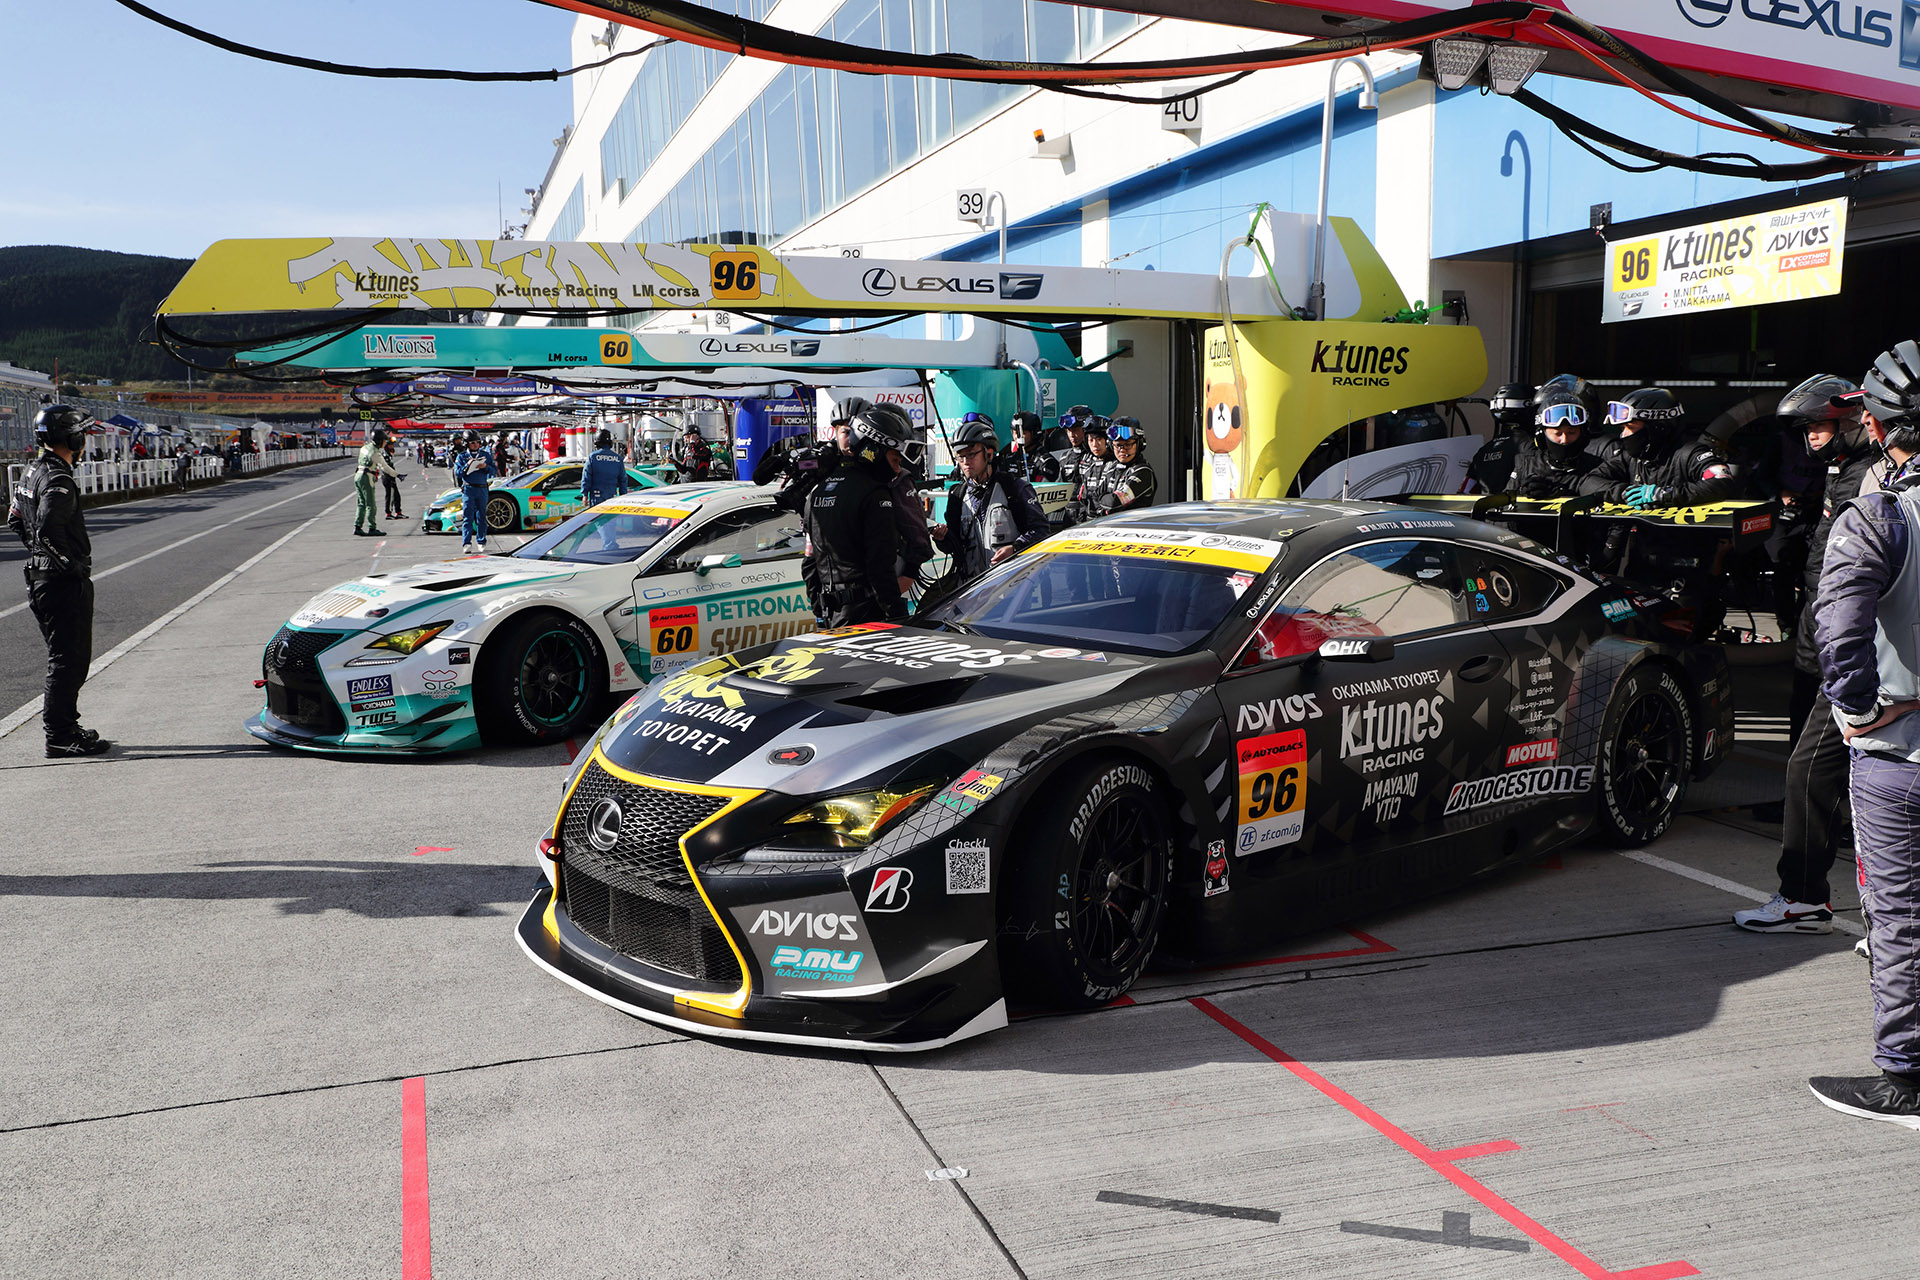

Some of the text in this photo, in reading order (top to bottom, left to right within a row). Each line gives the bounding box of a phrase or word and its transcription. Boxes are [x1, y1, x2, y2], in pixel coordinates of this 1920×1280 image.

[1740, 0, 1893, 48] LEXUS
[1165, 94, 1199, 122] 40
[959, 193, 983, 215] 39
[1770, 208, 1830, 228] 岡山トヨペット
[1767, 226, 1829, 253] ADVICS
[1622, 247, 1650, 283] 96
[1680, 266, 1734, 282] RACING
[714, 261, 757, 292] 96
[900, 275, 994, 293] LEXUS
[496, 284, 700, 299] K-tunes Racing LM corsa
[1673, 293, 1731, 309] Y.NAKAYAMA
[1674, 286, 1708, 298] M.NITTA
[715, 313, 729, 325] 36
[548, 353, 588, 362] LM corsa
[603, 341, 628, 358] 60
[725, 343, 788, 353] LEXUS
[1332, 376, 1389, 387] RACING
[875, 393, 924, 404] DENSO
[361, 410, 371, 418] 35
[1637, 408, 1678, 420] GIRO
[857, 423, 900, 448] GIRO
[533, 501, 542, 510] 52
[1114, 533, 1163, 541] LEXUS
[741, 570, 786, 585] OBERON
[643, 579, 732, 600] Corniche
[1254, 586, 1274, 611] LEXUS
[659, 612, 696, 621] AUTOBACS
[569, 620, 597, 657] ADVAN
[656, 625, 693, 654] 60
[824, 647, 933, 669] RACING
[351, 676, 390, 693] ENDLESS
[1332, 669, 1441, 701] OKAYAMA TOYOPET
[362, 700, 395, 710] YOKOHAMA
[1236, 692, 1324, 733] ADVICS
[356, 711, 397, 726] TWS
[513, 702, 538, 735] YOKOHAMA
[661, 699, 756, 733] OKAYAMA
[1530, 710, 1543, 722] L&F
[632, 720, 731, 756] TOYOPET
[1252, 741, 1304, 759] AUTOBACS
[1507, 741, 1555, 765] MOTUL
[1362, 747, 1425, 774] RACING
[1248, 766, 1299, 820] 96
[1443, 766, 1596, 816] BRIDGESTONE
[1602, 740, 1635, 836] POTENZA
[938, 795, 974, 813] TACTI
[1070, 765, 1154, 845] BRIDGESTONE
[948, 838, 986, 848] Check!
[1240, 829, 1256, 848] ZF
[1260, 823, 1301, 843] zf.com/jp
[749, 910, 858, 941] ADVICS
[771, 945, 863, 973] P.MU
[775, 968, 855, 983] RACING PADS
